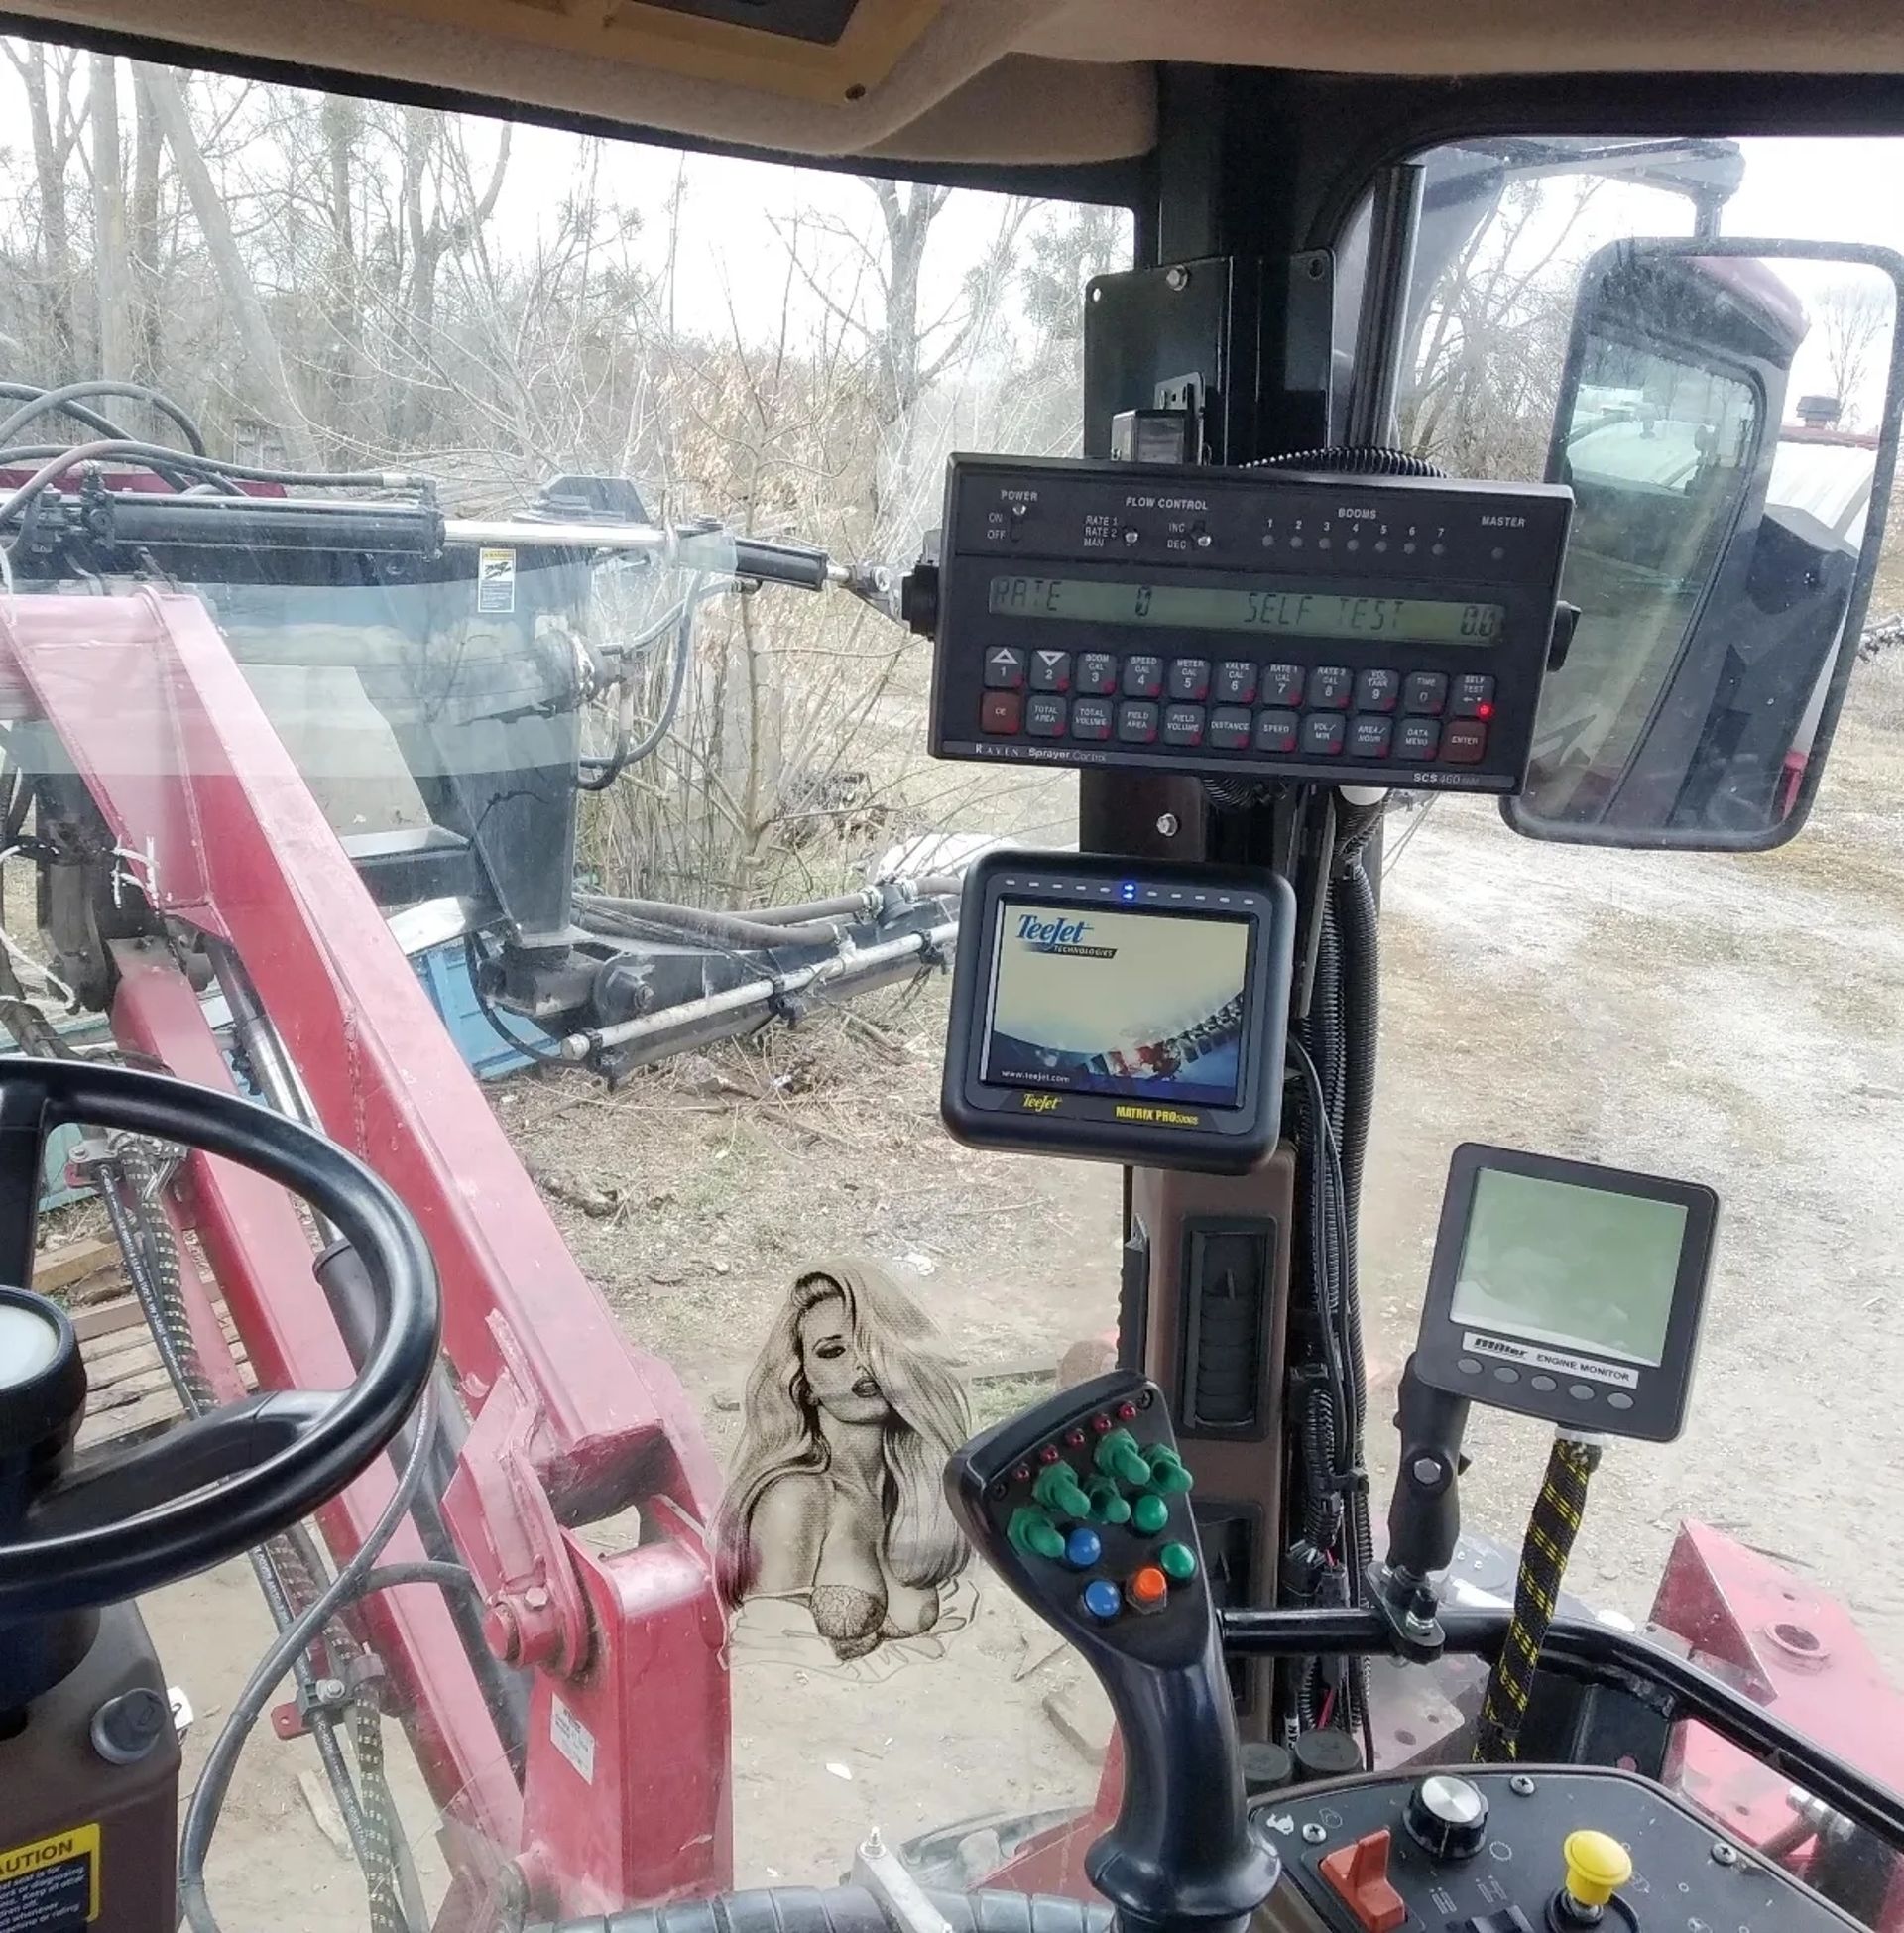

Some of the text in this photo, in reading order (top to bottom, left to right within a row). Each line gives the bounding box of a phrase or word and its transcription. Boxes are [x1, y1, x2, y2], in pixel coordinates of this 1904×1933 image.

[1001, 489, 1038, 502] POWER
[1126, 497, 1208, 510] FLOW CONTROL
[989, 513, 1003, 523] ON
[1338, 507, 1377, 520] BOOMS
[1085, 515, 1119, 526] RATE 1
[1482, 515, 1526, 528] MASTER
[1085, 526, 1118, 538] RATE 2
[1169, 522, 1185, 533] INC
[1267, 518, 1445, 538] 1 2 3 4 5 6 7
[987, 530, 1006, 540] OFF
[1084, 538, 1105, 547] MAN
[1167, 540, 1187, 549] DEC
[993, 578, 1062, 612] RATE
[1135, 585, 1152, 617] 0
[1244, 592, 1313, 625] SELF
[1339, 597, 1404, 631] TEST
[1177, 659, 1205, 667] METER
[1225, 662, 1250, 671] VALVE
[1000, 665, 1007, 677] 1
[1270, 664, 1290, 673] RATE
[1317, 667, 1339, 676] RATE
[1045, 669, 1053, 681] 2
[1092, 672, 1100, 683] 3
[1229, 670, 1244, 679] CAL
[1275, 673, 1290, 682] CAL
[1464, 675, 1485, 684] SELF
[1137, 675, 1145, 685] 4
[1183, 677, 1192, 688] 5
[1322, 676, 1338, 685] CAL
[1368, 677, 1388, 687] TANK
[1416, 677, 1436, 687] TIME
[1231, 680, 1239, 691] 6
[1277, 683, 1286, 694] 7
[1463, 684, 1485, 693] TEST
[1324, 686, 1333, 697] 8
[1371, 688, 1380, 699] 9
[1034, 705, 1059, 714] TOTAL
[1080, 707, 1105, 717] TOTAL
[1034, 714, 1056, 723] AREA
[1127, 711, 1149, 720] FIELD
[1173, 713, 1195, 722] FIELD
[1075, 716, 1108, 726] VOLUME
[1127, 719, 1148, 729] AREA
[1211, 721, 1250, 731] DISTANCE
[1167, 722, 1199, 732] VOLUME
[1263, 724, 1289, 733] SPEED
[1315, 731, 1331, 740] MIN
[1407, 728, 1429, 737] DATA
[1406, 737, 1428, 746] MENU
[1451, 736, 1479, 745] ENTER
[975, 743, 1019, 757] RAVEN
[1028, 747, 1070, 761] Sprayer
[1413, 772, 1438, 784] SCS
[1015, 913, 1094, 946] TeeJet
[1054, 944, 1114, 958] TECHNOLOGIES
[1001, 1069, 1070, 1084] www.teejet.com
[1022, 1093, 1063, 1113] TeeJet
[1116, 1106, 1153, 1121] MATRIX
[1537, 1354, 1578, 1371] ENGINE
[1580, 1364, 1630, 1382] MONITOR
